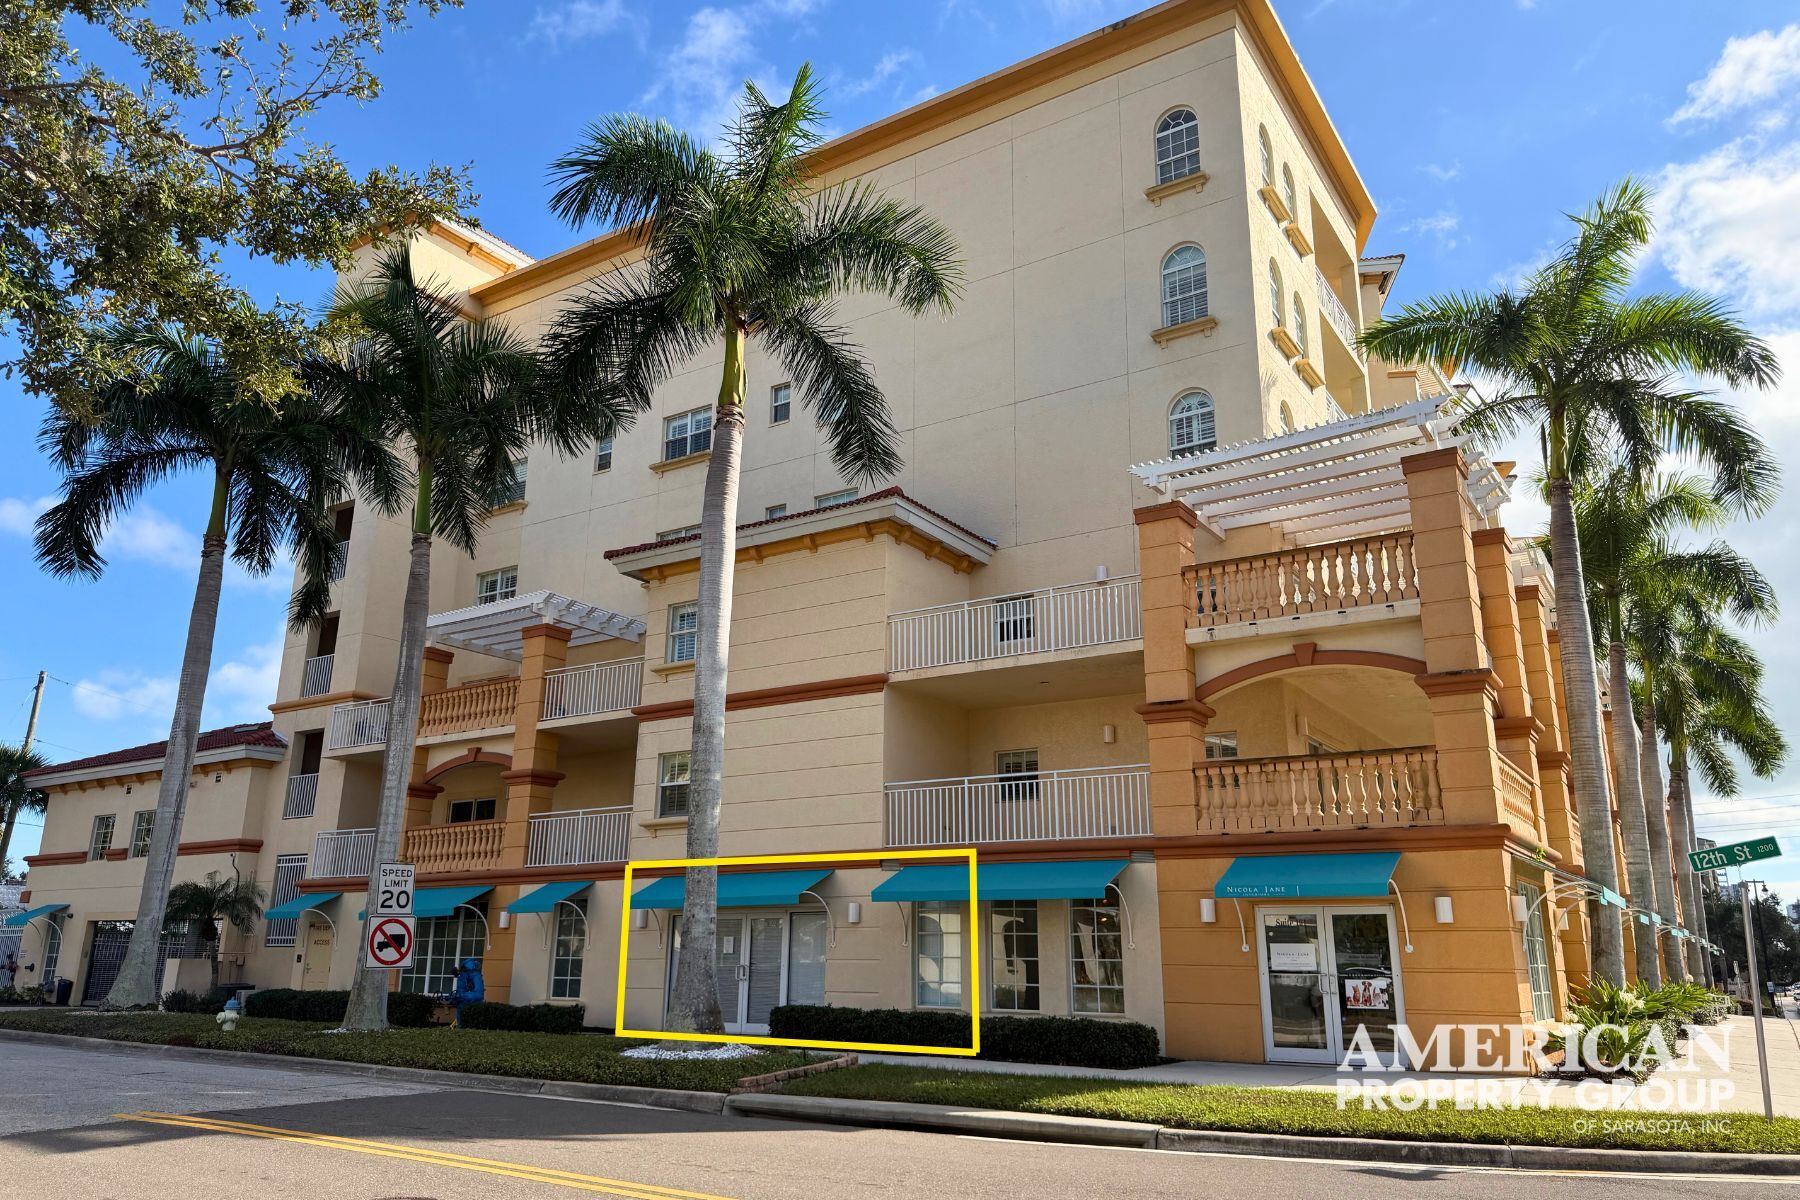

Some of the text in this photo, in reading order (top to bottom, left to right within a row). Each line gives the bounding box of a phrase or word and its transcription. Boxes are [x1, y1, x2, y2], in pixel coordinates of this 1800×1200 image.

[1756, 843, 1774, 853] 1200
[1693, 845, 1753, 869] 12th St
[382, 869, 413, 878] SPEED
[384, 880, 409, 888] LIMIT
[380, 890, 410, 909] 20
